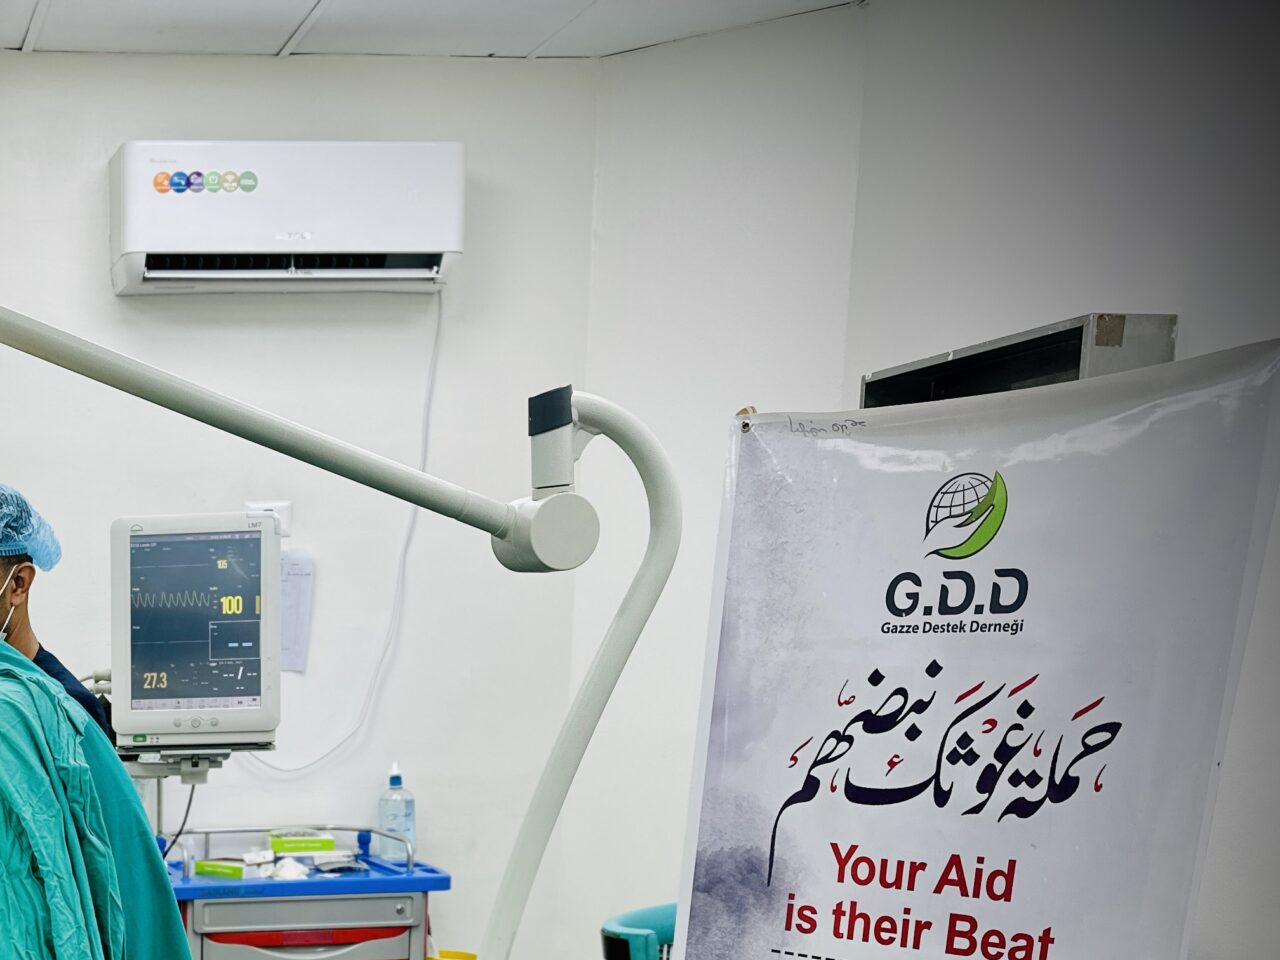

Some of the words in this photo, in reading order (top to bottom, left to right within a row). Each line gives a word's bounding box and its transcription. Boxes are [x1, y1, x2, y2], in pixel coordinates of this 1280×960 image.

[217, 560, 228, 569] 105
[885, 568, 1029, 618] G.D.D
[220, 595, 243, 614] 100
[881, 621, 920, 634] Gazze
[922, 620, 967, 634] Destek
[969, 619, 1024, 636] Derneği
[143, 672, 168, 689] 27.3
[829, 842, 928, 891] Your
[932, 853, 1017, 902] Aid
[784, 893, 818, 934] is
[832, 900, 933, 950] their
